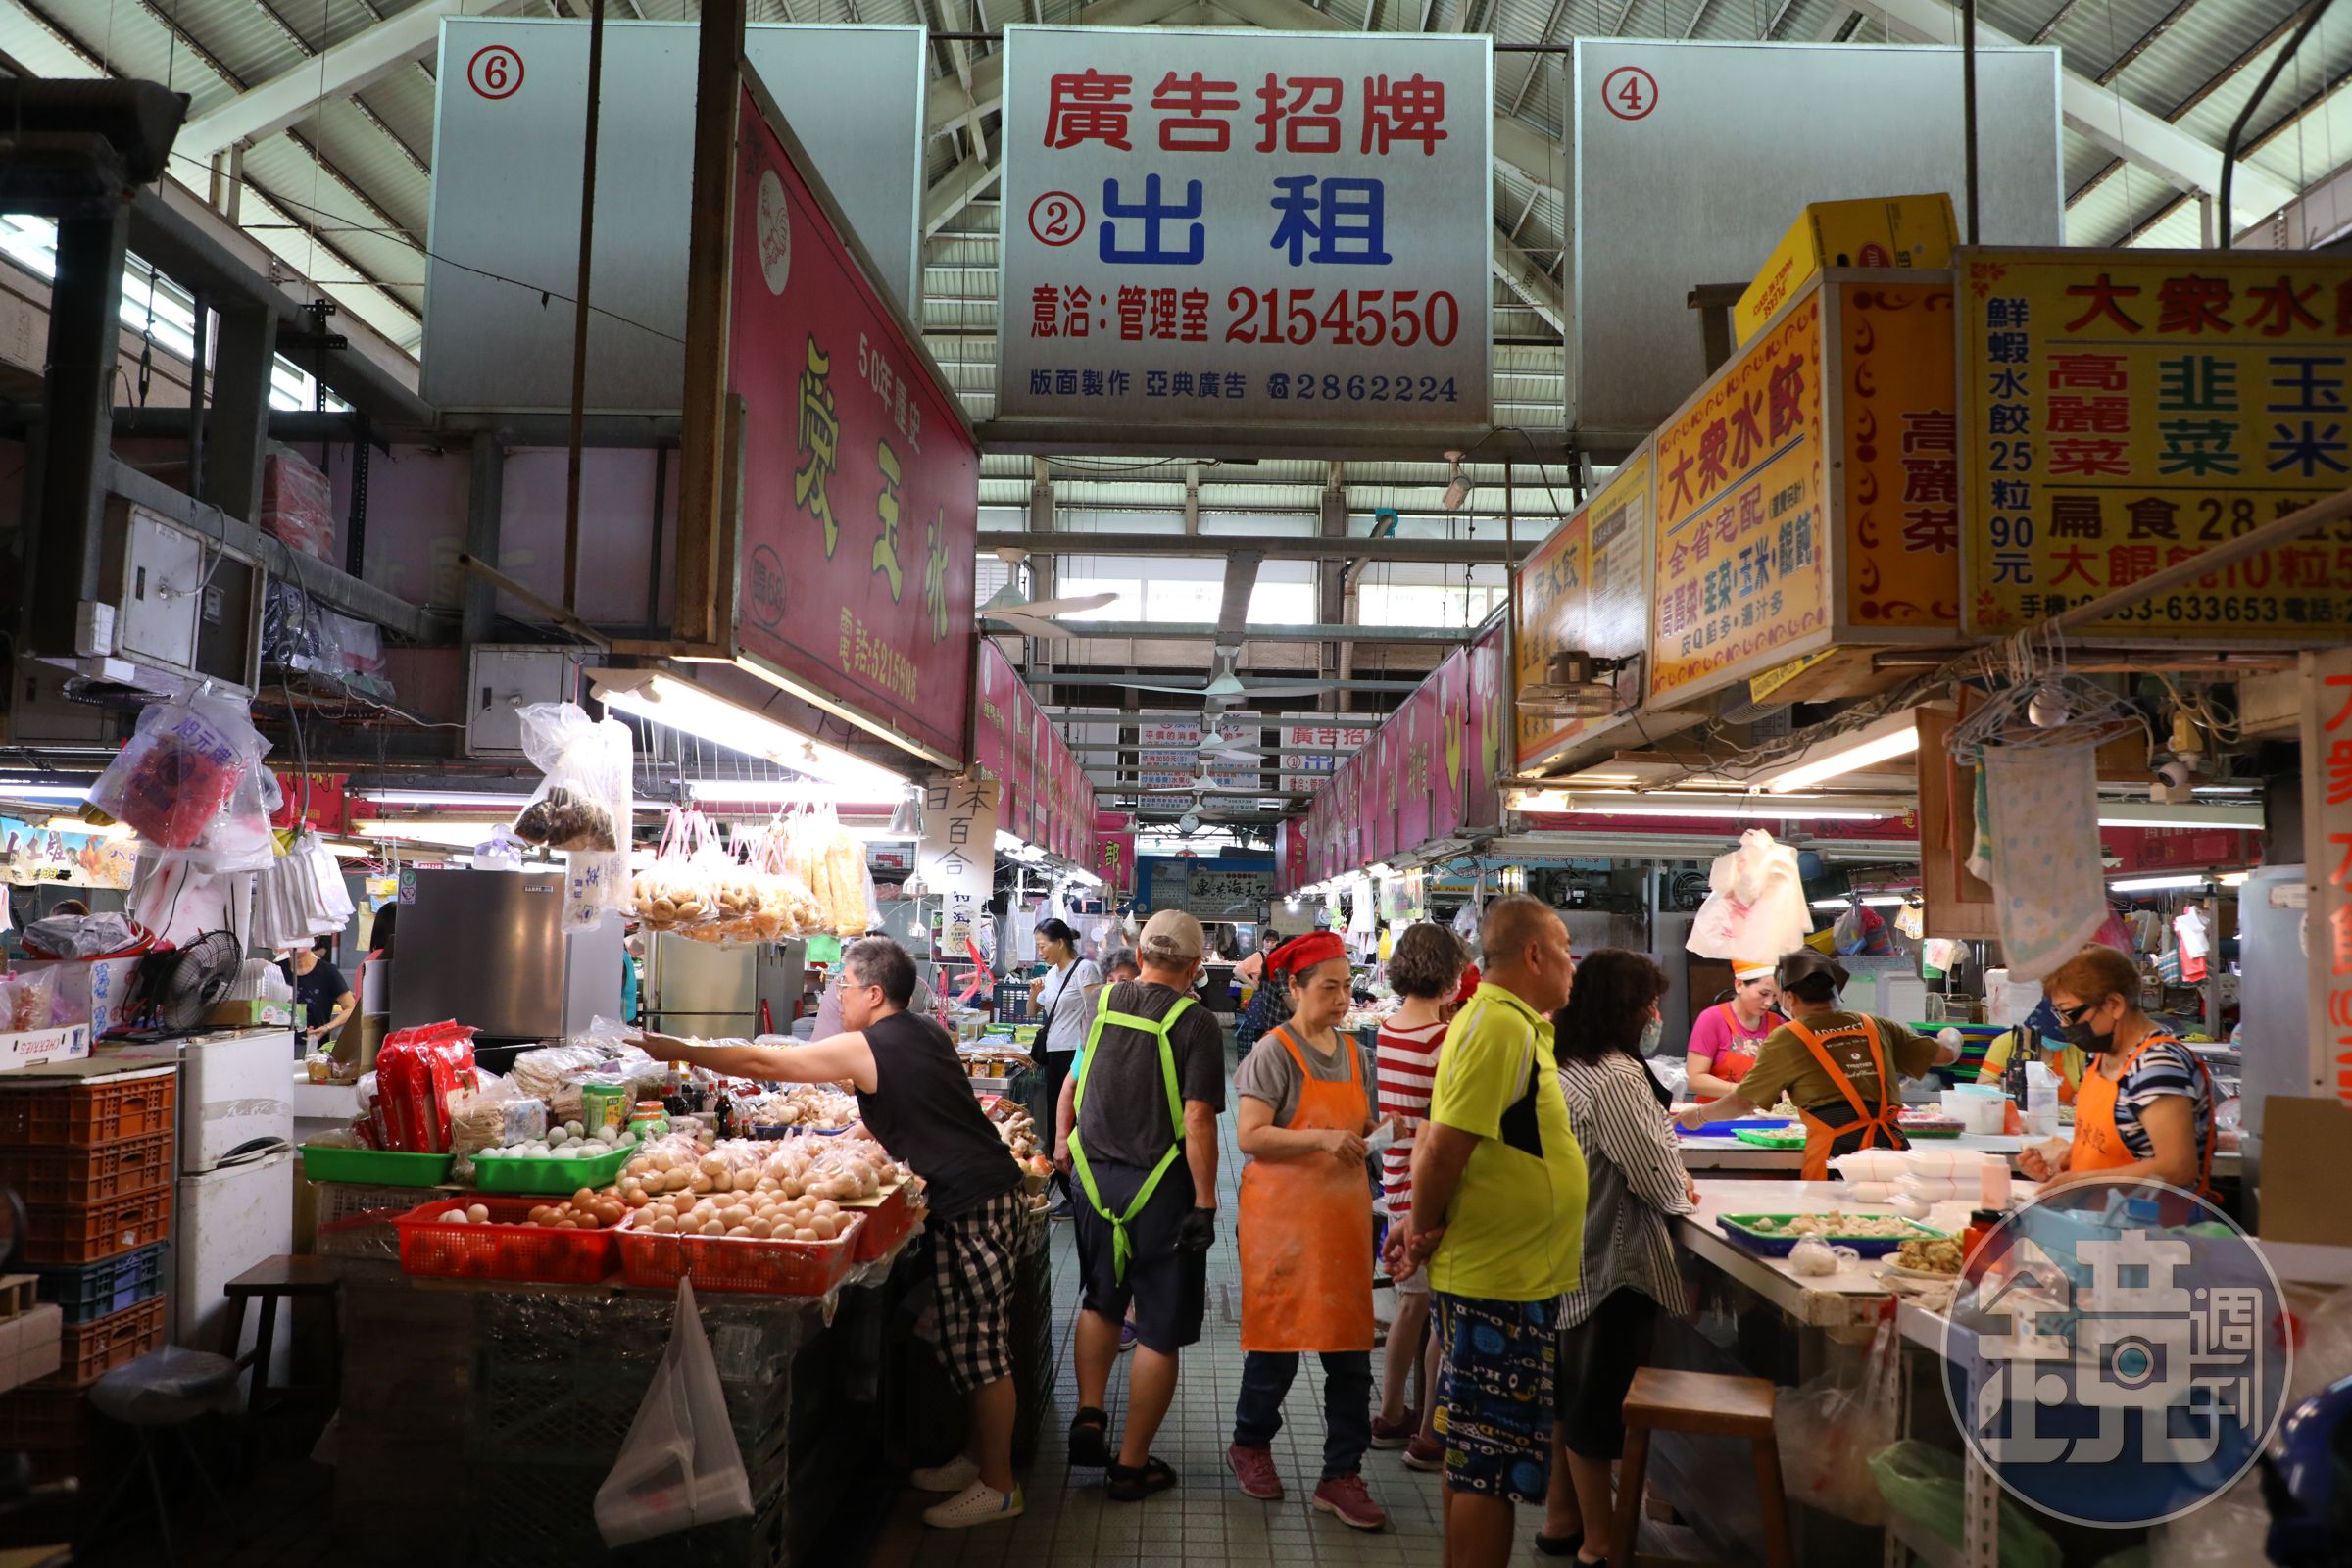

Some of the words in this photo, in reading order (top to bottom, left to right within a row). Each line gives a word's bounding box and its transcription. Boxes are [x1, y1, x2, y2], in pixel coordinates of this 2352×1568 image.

[1044, 67, 1448, 157] 廣告招牌
[1099, 173, 1392, 266] 出租
[1226, 286, 1458, 347] 2154550
[858, 332, 923, 456] 50年歷史
[1029, 369, 1130, 397] 版面製作
[1146, 371, 1247, 399] 亞典廣告
[2046, 353, 2131, 477] 高麗菜
[2158, 354, 2241, 477] 韭菜
[2267, 356, 2352, 478] 玉米
[1668, 482, 1766, 579] 全省宅配
[1901, 409, 1958, 555] 高麗菜
[926, 785, 993, 816] 日本
